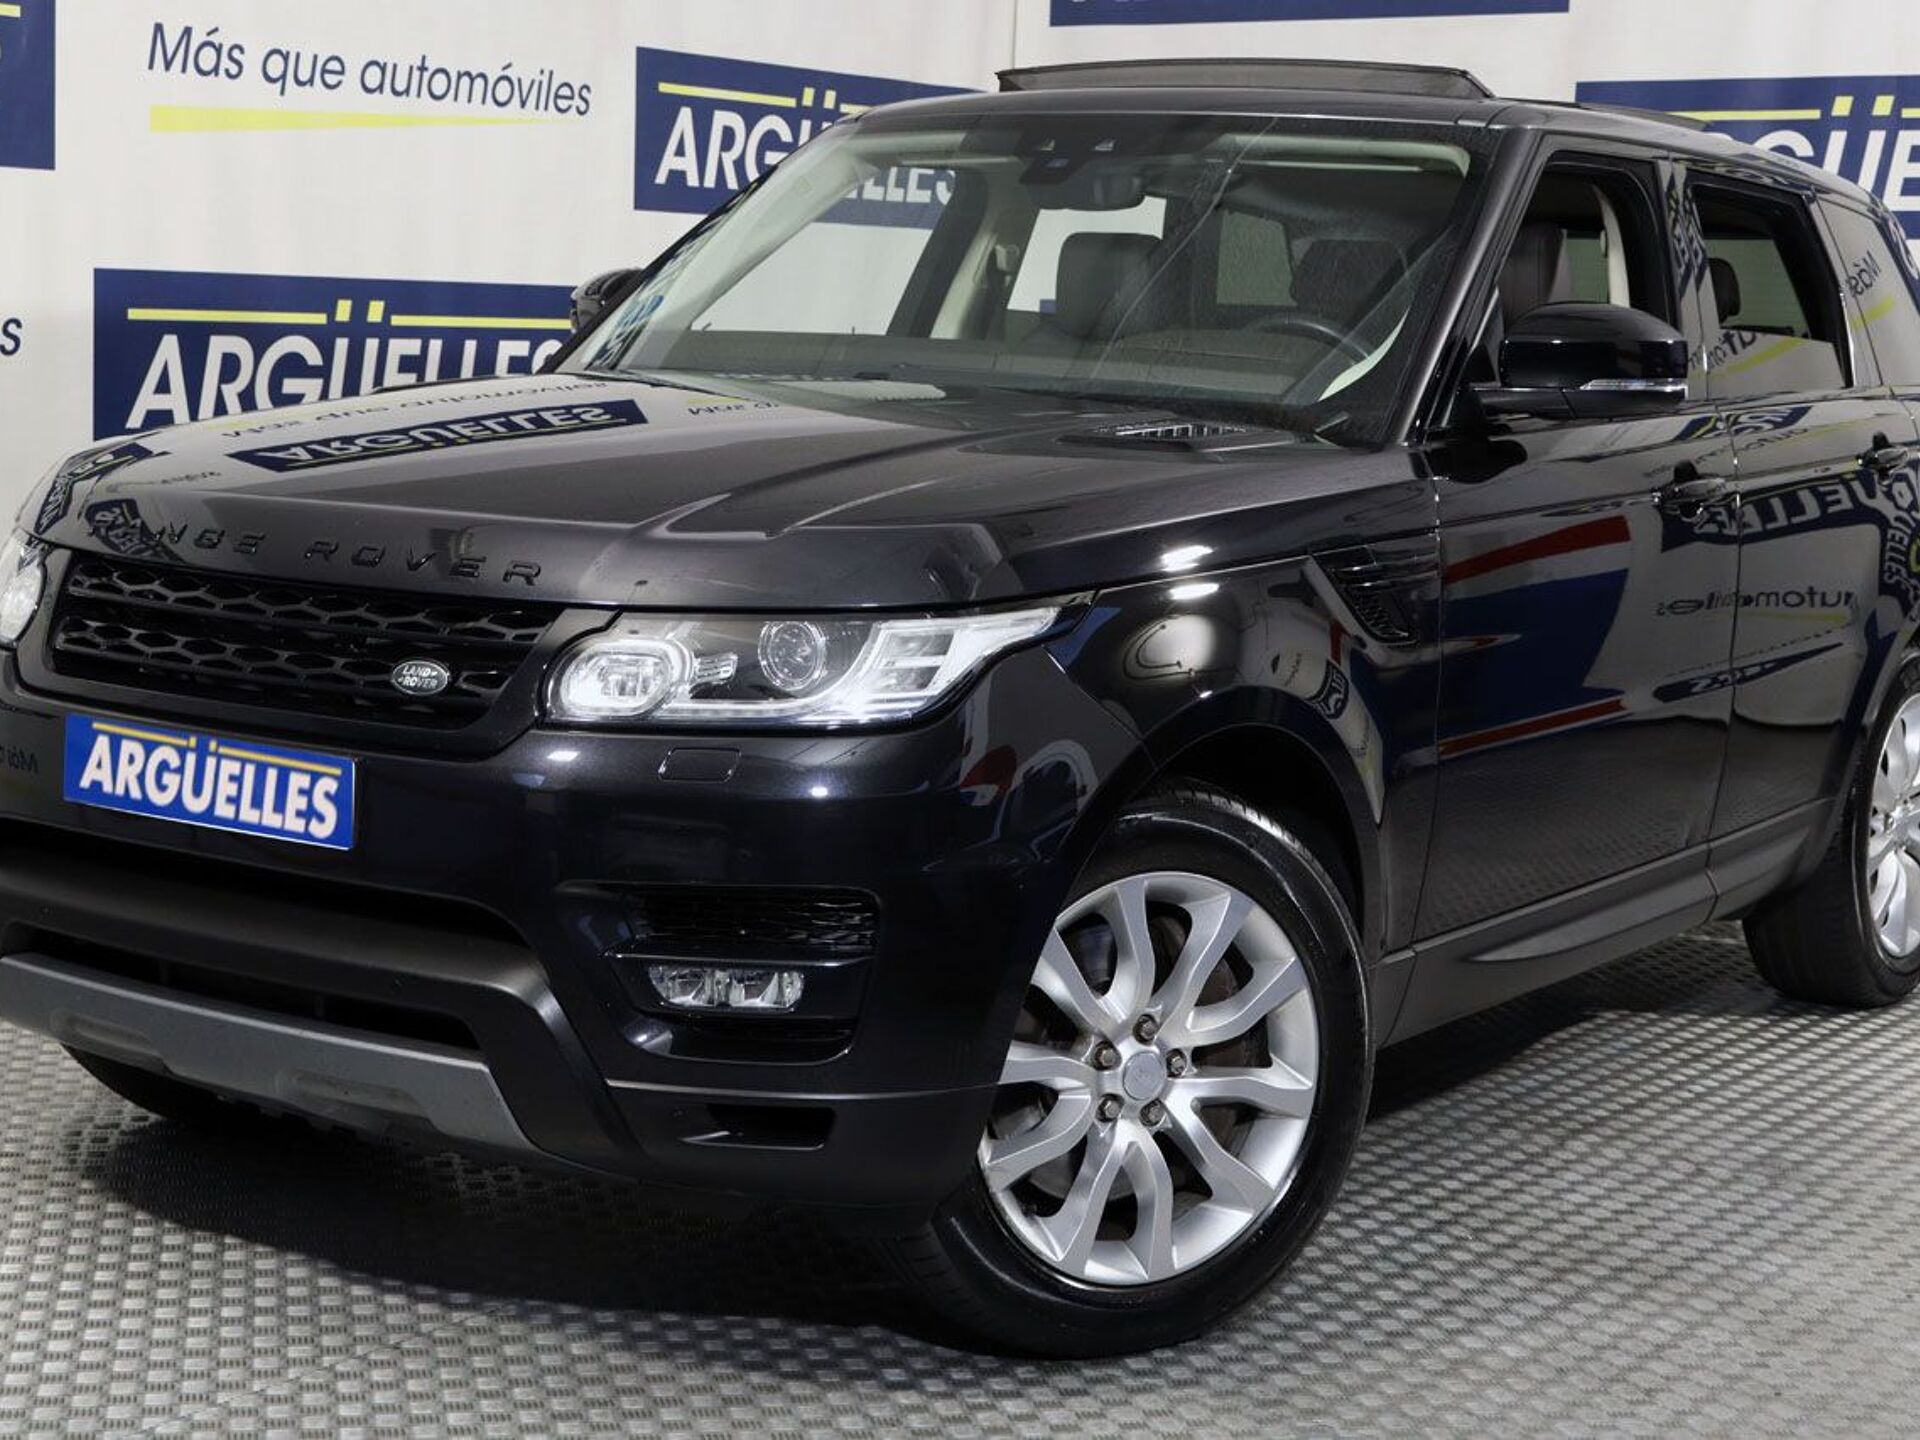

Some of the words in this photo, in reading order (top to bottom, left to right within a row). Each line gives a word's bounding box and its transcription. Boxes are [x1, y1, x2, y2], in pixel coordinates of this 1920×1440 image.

[147, 21, 245, 80] Más
[260, 46, 346, 96] que
[359, 54, 593, 116] automóviles
[402, 664, 432, 677] LAND
[402, 676, 438, 689] ROVER
[79, 733, 339, 840] ARGÜELLES
